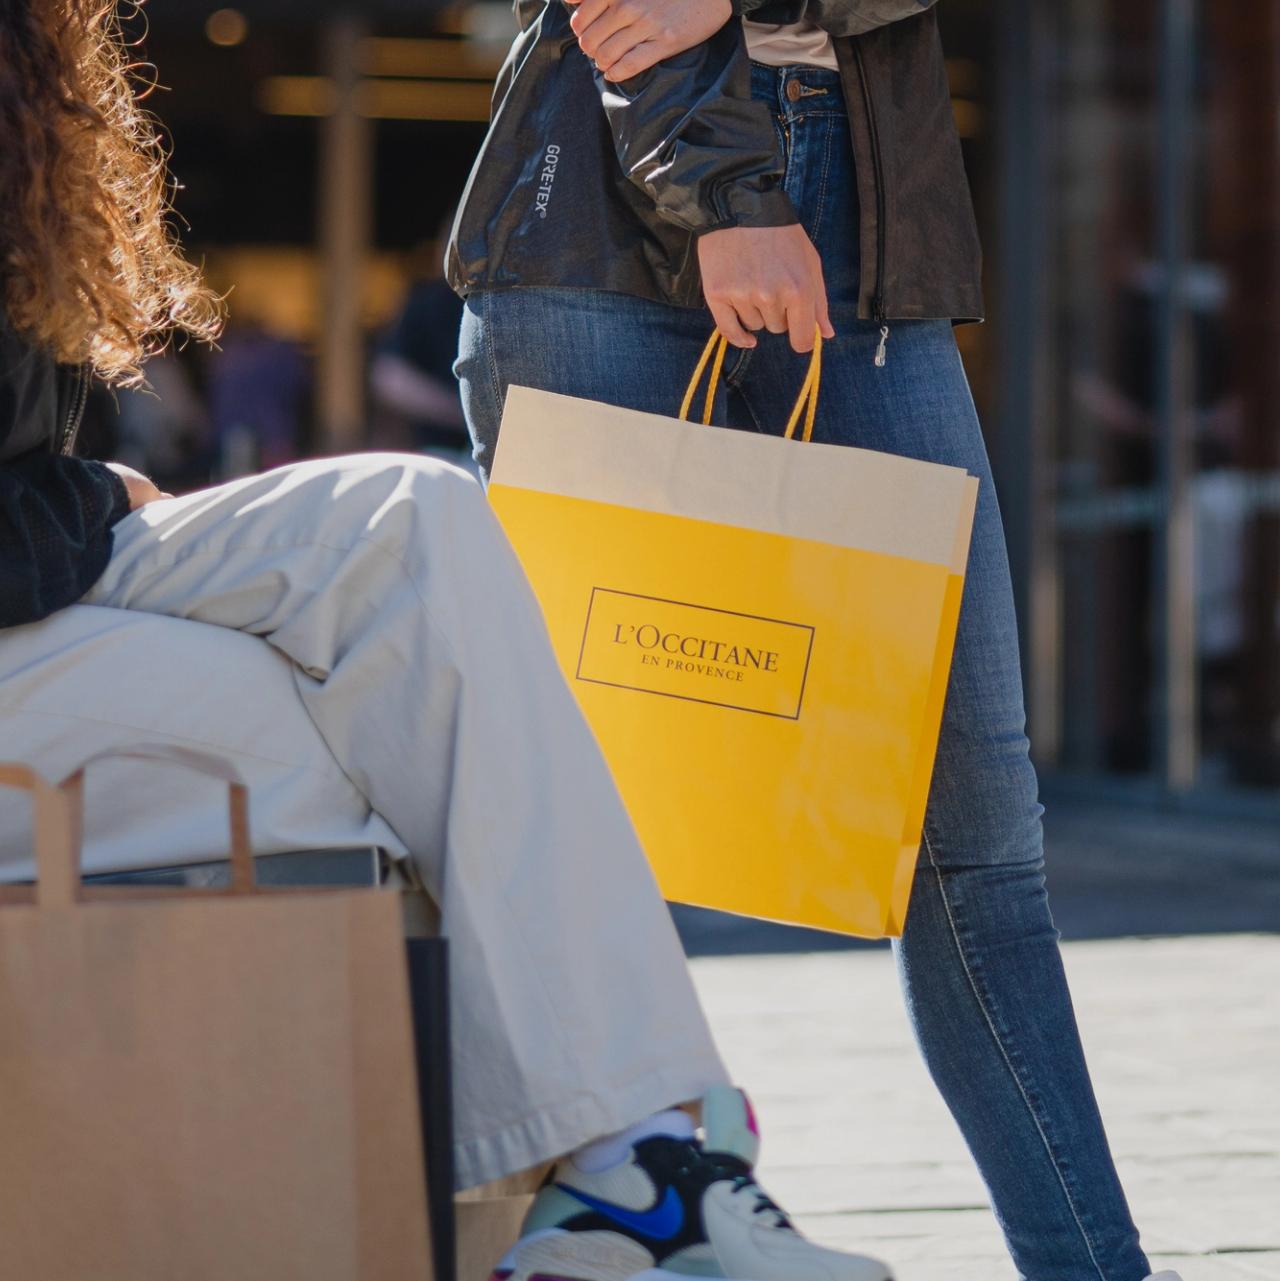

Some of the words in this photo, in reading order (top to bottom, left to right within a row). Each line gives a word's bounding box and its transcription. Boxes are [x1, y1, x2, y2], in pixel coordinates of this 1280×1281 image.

[613, 624, 780, 673] L'OCCITANE
[640, 654, 661, 667] EN
[665, 658, 745, 683] PROVENCE
